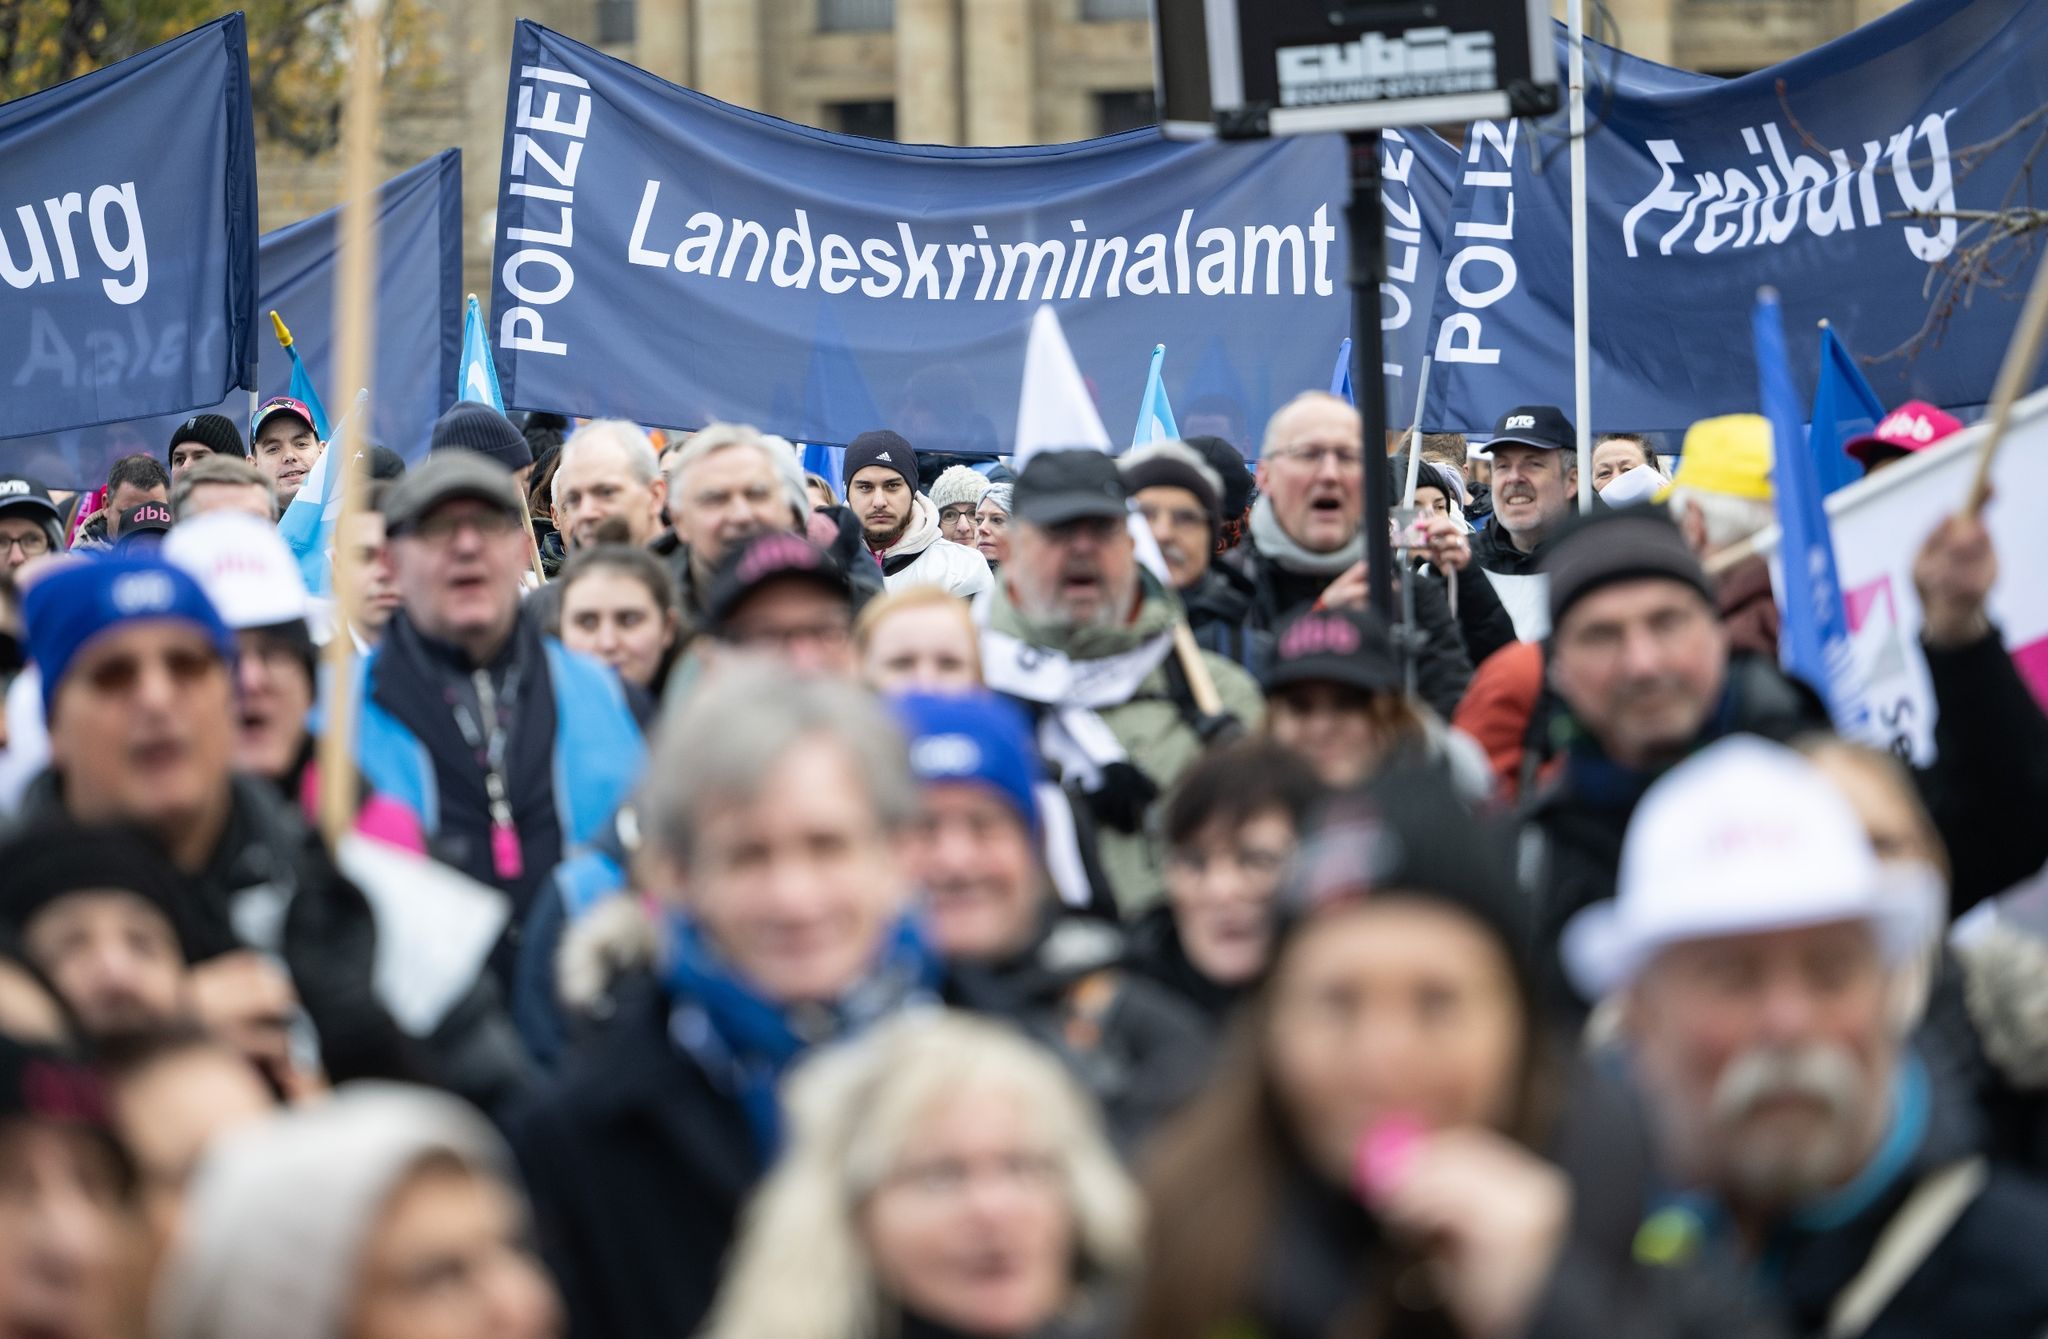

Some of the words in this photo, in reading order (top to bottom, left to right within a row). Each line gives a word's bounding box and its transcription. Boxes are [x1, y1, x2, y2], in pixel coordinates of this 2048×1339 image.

[0, 181, 149, 305] urg
[500, 65, 591, 356] POLIZEI
[629, 180, 1336, 300] Landeskriminalamt
[1622, 108, 1957, 262] Freiburg
[133, 505, 171, 523] dbb
